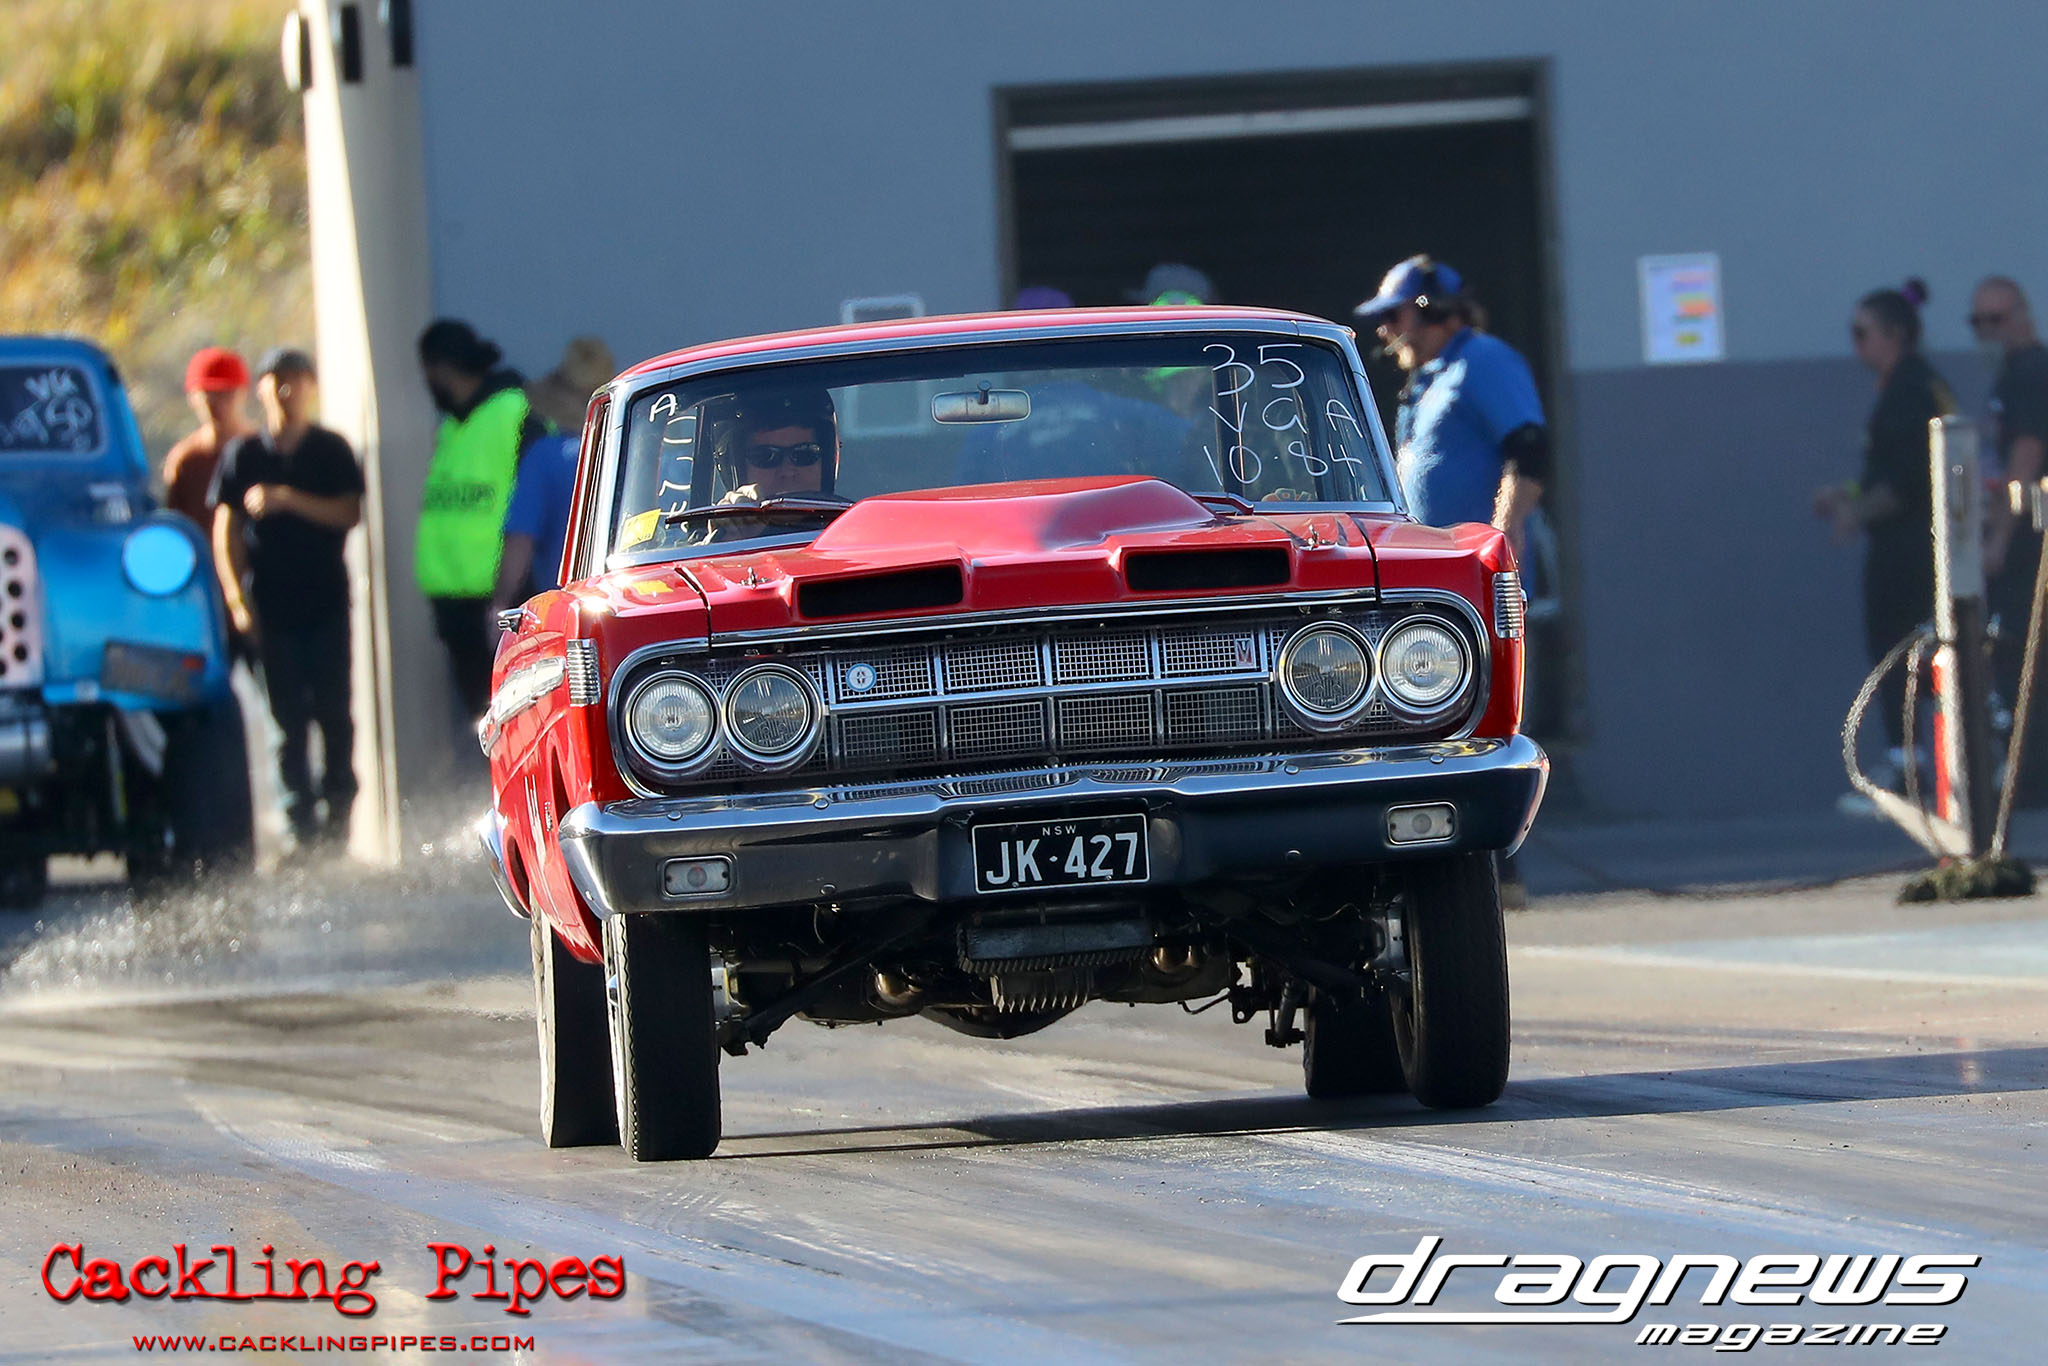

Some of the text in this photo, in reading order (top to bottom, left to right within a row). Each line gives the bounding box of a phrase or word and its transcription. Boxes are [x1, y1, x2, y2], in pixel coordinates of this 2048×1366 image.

[1203, 343, 1305, 396] 35
[1203, 441, 1363, 487] 10.84
[1042, 825, 1077, 837] NSW
